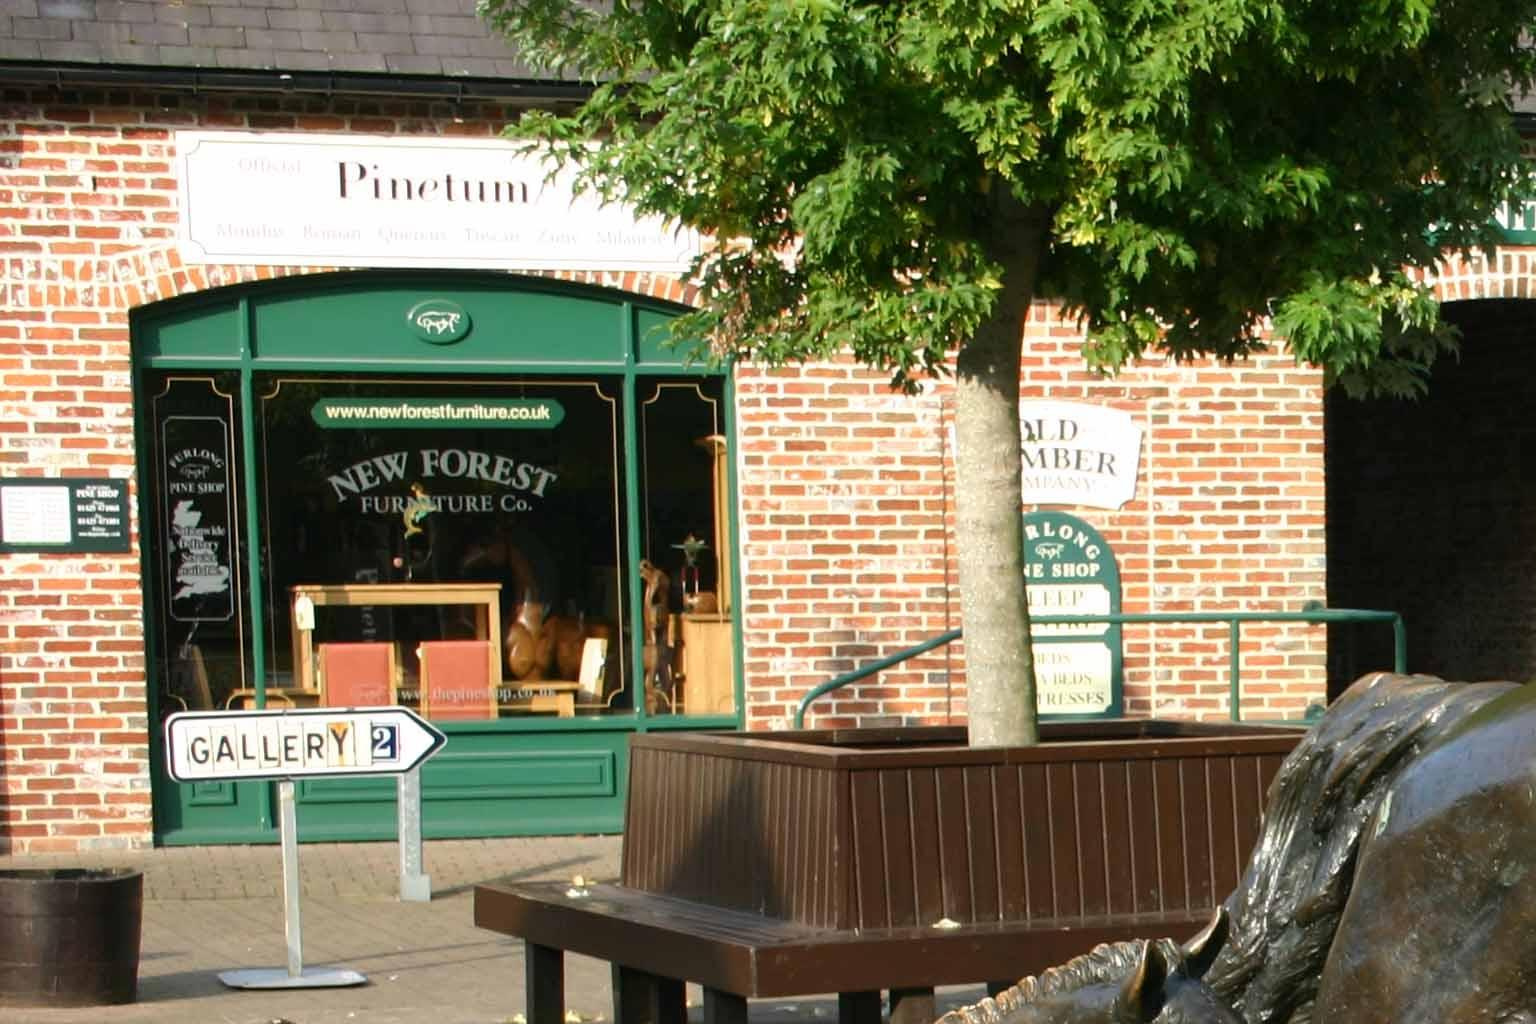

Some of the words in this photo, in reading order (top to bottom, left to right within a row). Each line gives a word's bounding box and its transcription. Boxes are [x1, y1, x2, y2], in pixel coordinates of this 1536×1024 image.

[338, 162, 528, 204] Pinetum
[325, 403, 551, 420] www.newforestfurniture.co.uk
[168, 447, 225, 469] FURLONG
[1020, 446, 1118, 478] MBER
[327, 451, 409, 503] NEW
[421, 449, 558, 499] FOREST
[170, 482, 195, 495] PINE
[197, 482, 225, 495] SHOP
[501, 495, 533, 511] Co.
[1025, 522, 1101, 560] RLONG
[1052, 563, 1101, 578] SHOP
[1028, 590, 1084, 607] LEEP
[190, 727, 350, 765] GALLERY
[372, 726, 393, 758] 2
